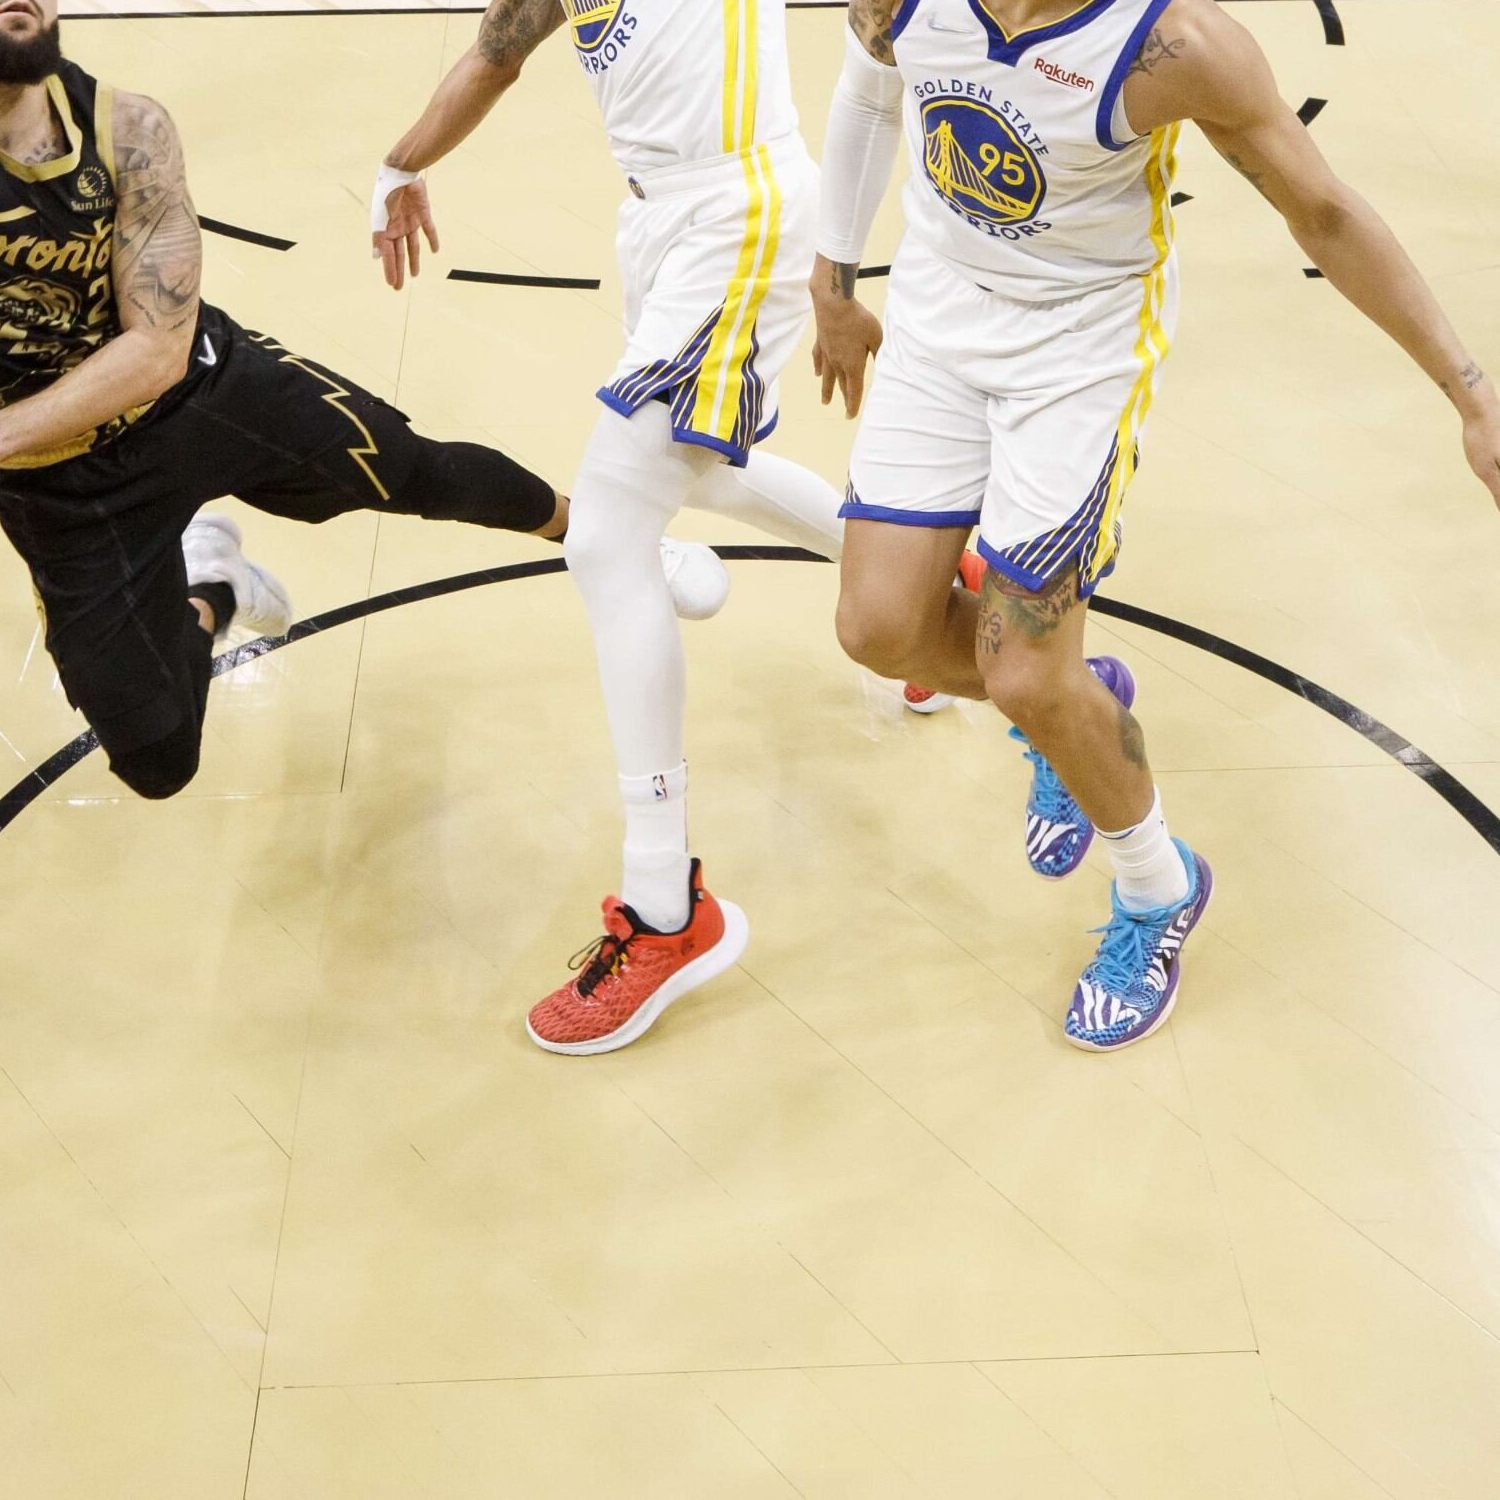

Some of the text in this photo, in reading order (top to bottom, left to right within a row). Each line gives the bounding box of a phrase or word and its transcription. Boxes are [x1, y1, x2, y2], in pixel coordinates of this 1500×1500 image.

[579, 11, 639, 76] RRIORS
[1033, 57, 1096, 93] Rakuten
[914, 78, 1050, 158] GOLDEN STATE
[979, 142, 1027, 188] 95
[70, 199, 93, 212] Sun
